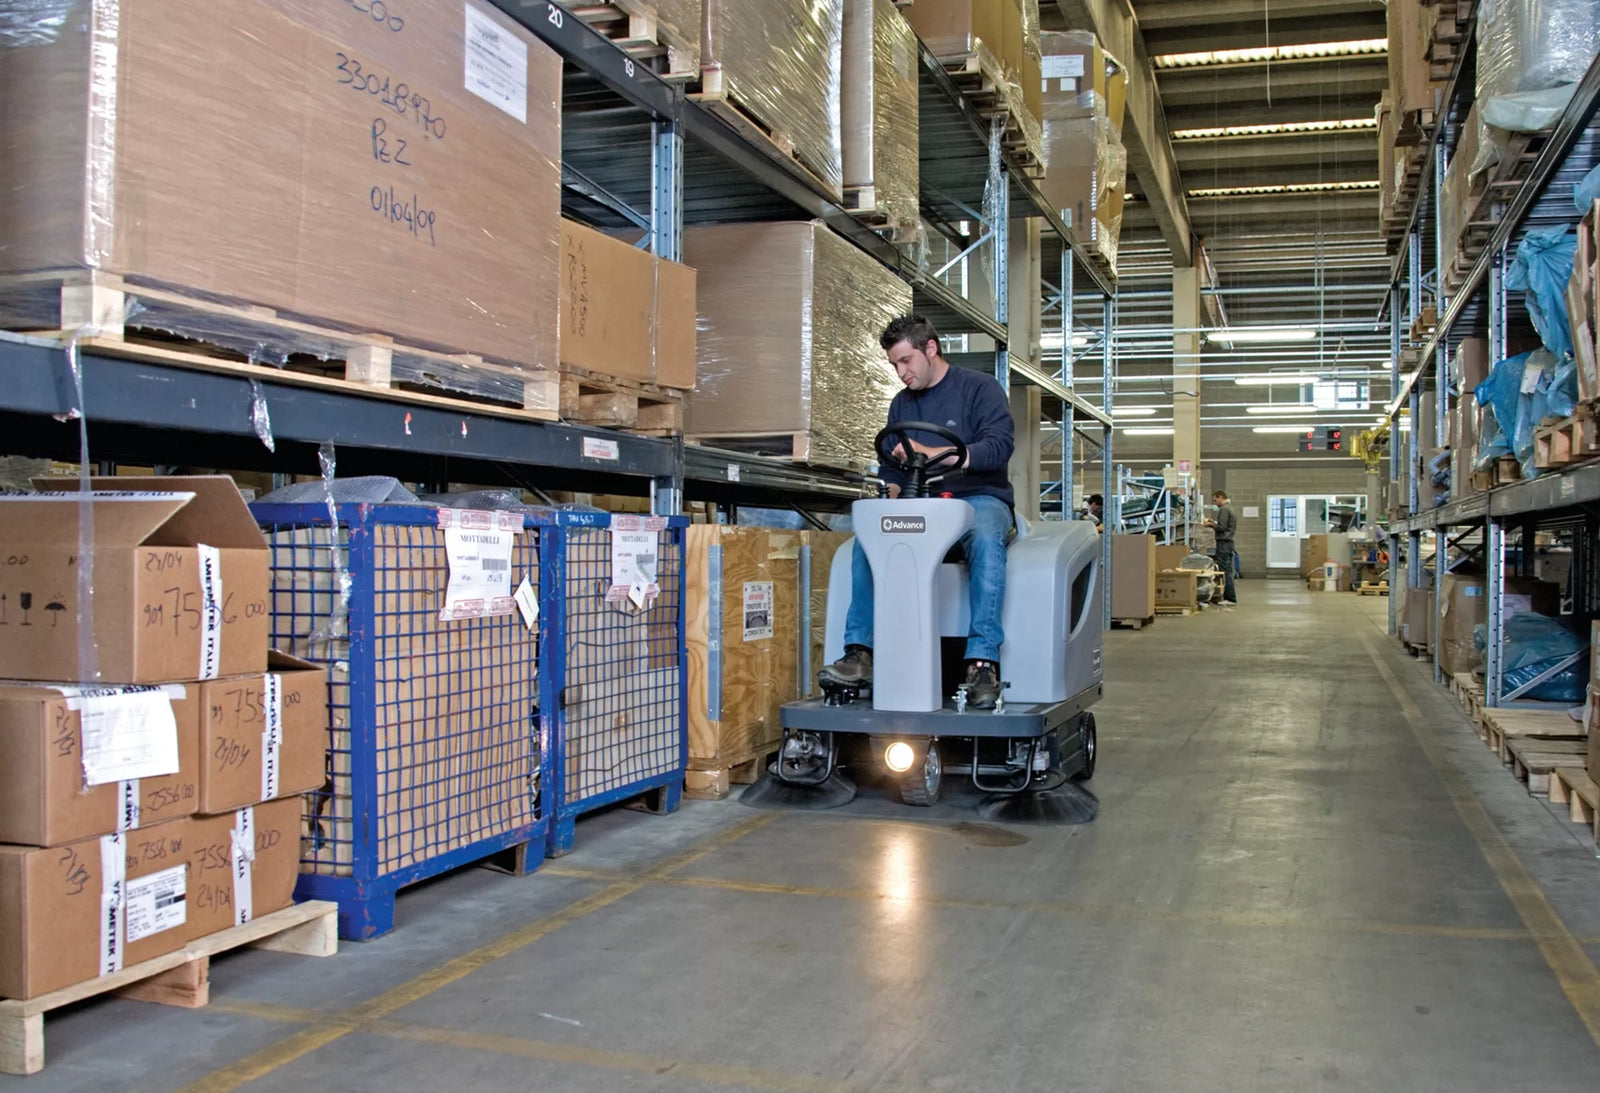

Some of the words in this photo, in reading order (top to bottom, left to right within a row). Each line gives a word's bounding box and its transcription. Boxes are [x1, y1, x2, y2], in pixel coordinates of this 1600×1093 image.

[548, 4, 563, 29] 20
[623, 58, 635, 78] 19
[371, 186, 436, 247] 01/04/09
[892, 520, 925, 529] Advance
[205, 637, 215, 679] ITALIA
